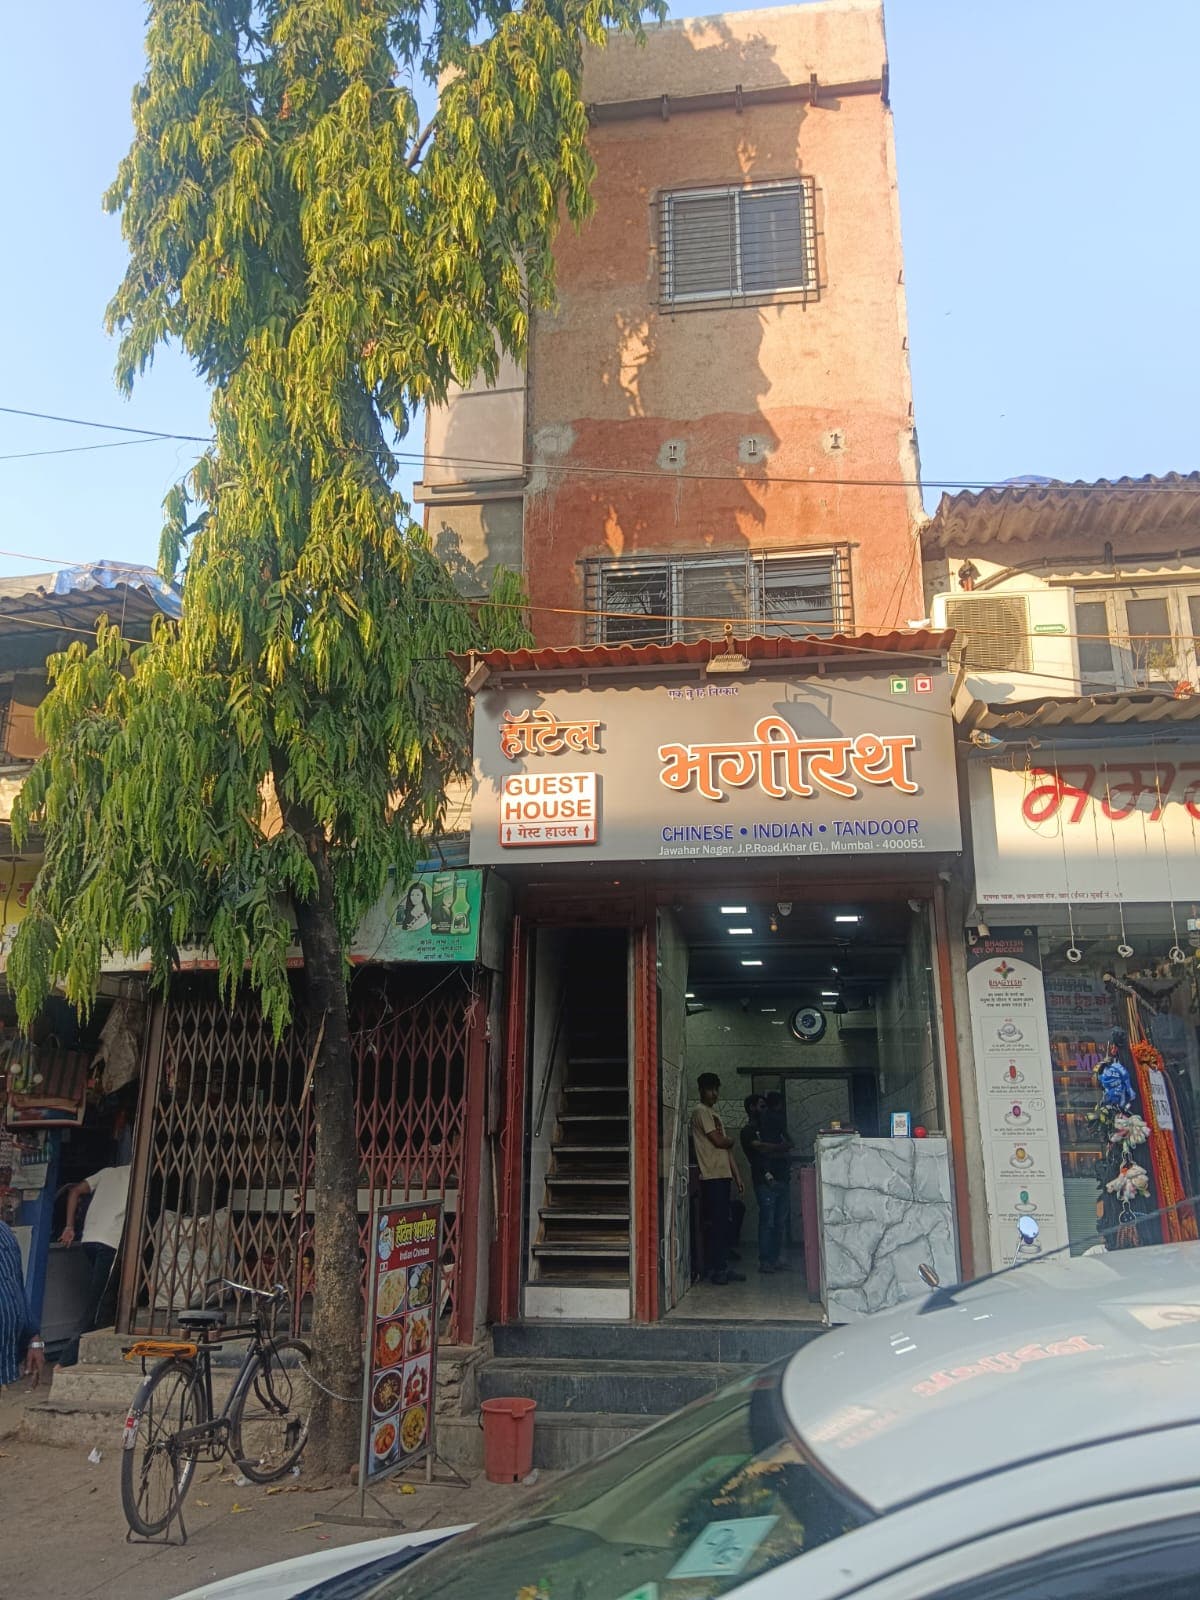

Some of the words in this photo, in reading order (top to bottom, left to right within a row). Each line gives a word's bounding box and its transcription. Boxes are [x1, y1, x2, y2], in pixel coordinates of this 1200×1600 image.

[501, 709, 601, 759] हॉटेल
[658, 715, 919, 800] भगीरथ
[505, 775, 589, 796] GUEST
[505, 799, 592, 820] HOUSE
[518, 824, 541, 839] गेस्ट
[545, 825, 578, 838] हाउस
[662, 824, 734, 842] CHINESE
[753, 821, 813, 840] INDIAN
[832, 819, 919, 836] TANDOOR
[659, 845, 700, 856] Jawahar
[831, 840, 873, 851] Mumbai
[882, 838, 926, 849] 400051
